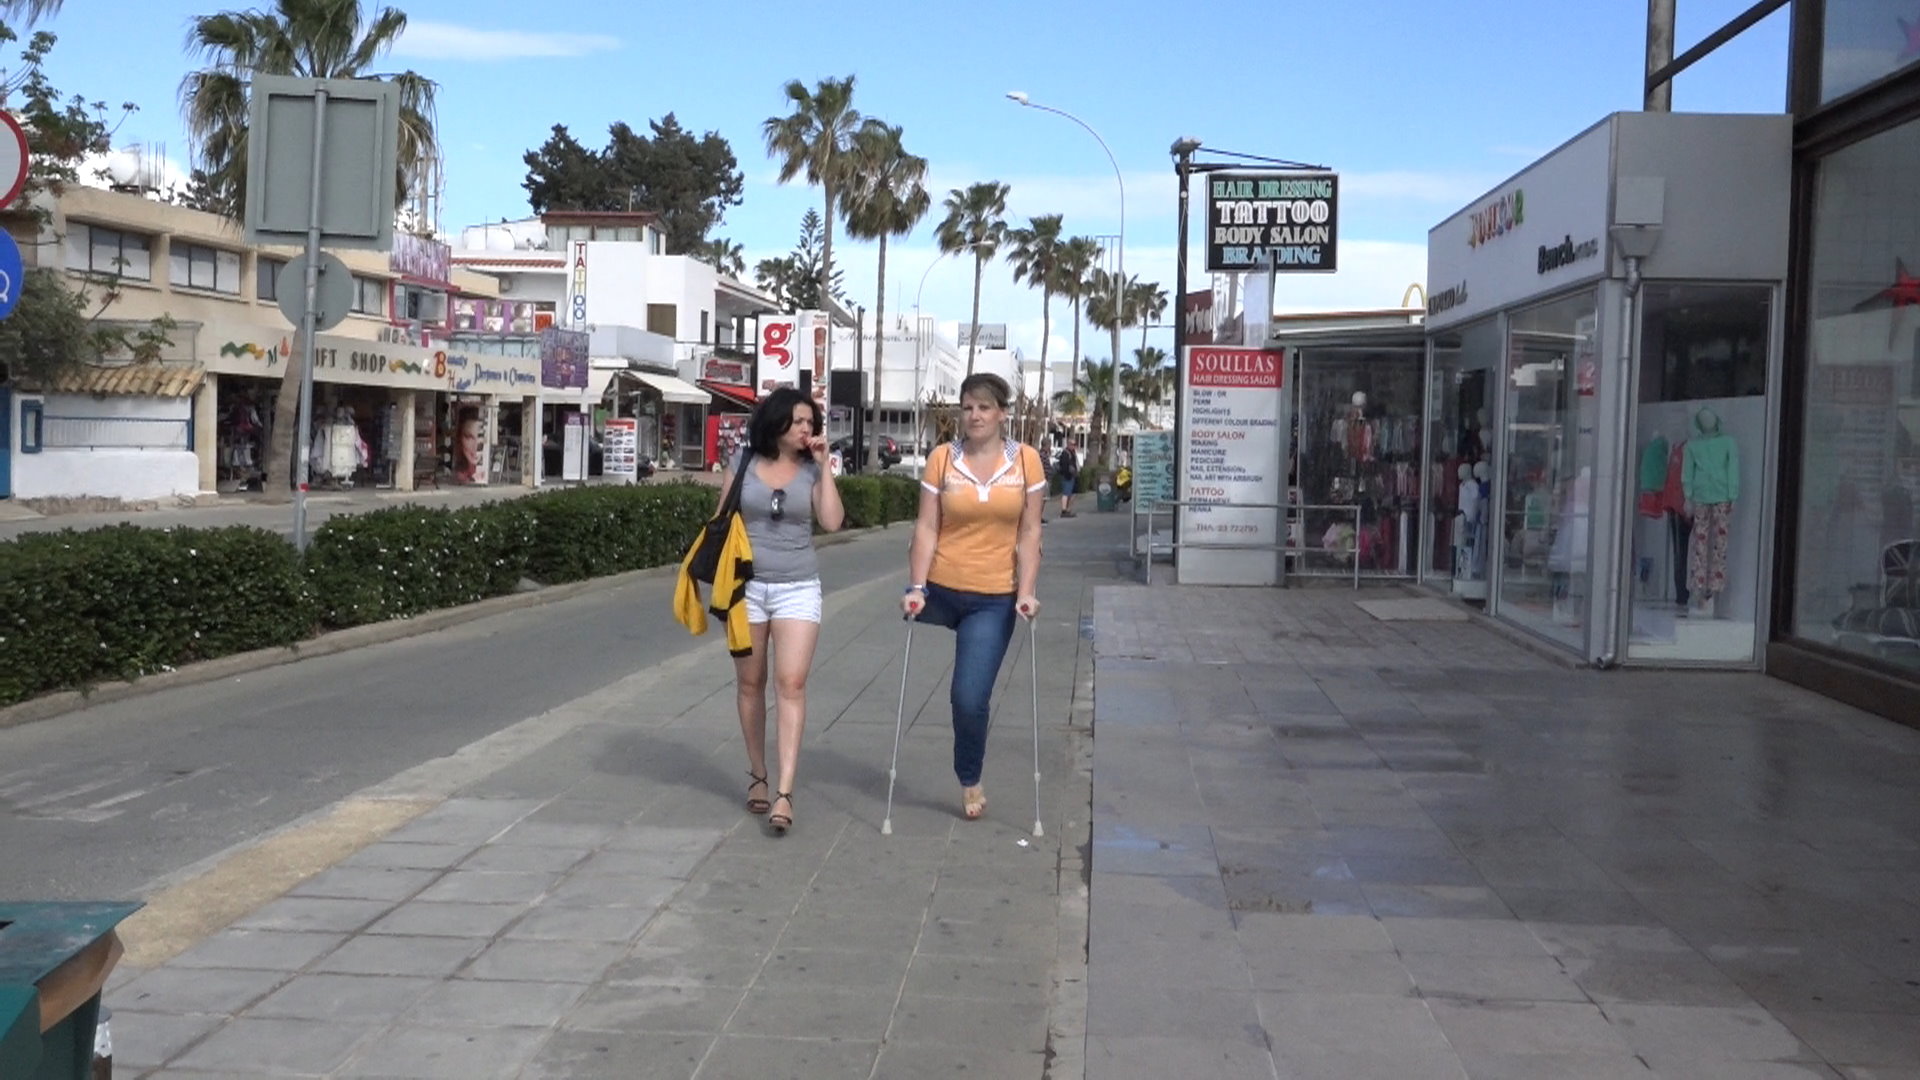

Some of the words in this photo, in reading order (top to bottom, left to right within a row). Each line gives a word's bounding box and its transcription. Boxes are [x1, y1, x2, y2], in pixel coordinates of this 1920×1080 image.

[1213, 180, 1254, 198] HAIR
[1258, 180, 1332, 198] DRESSING
[1216, 200, 1329, 224] TATTOO
[1214, 226, 1265, 245] BODY
[1270, 226, 1329, 245] SALON
[1222, 245, 1321, 264] BRADING
[574, 243, 585, 321] TATTOO
[350, 351, 387, 373] SHOP
[1195, 352, 1275, 372] SOULLAS
[1193, 373, 1212, 384] HAIR
[1213, 374, 1249, 384] DRESSING
[1250, 375, 1276, 385] SALON
[1191, 430, 1215, 439] BODY
[1217, 431, 1245, 440] SALON
[1190, 448, 1227, 456] MANICURE
[1190, 465, 1205, 473] NAIL
[1190, 487, 1225, 496] TATTOO
